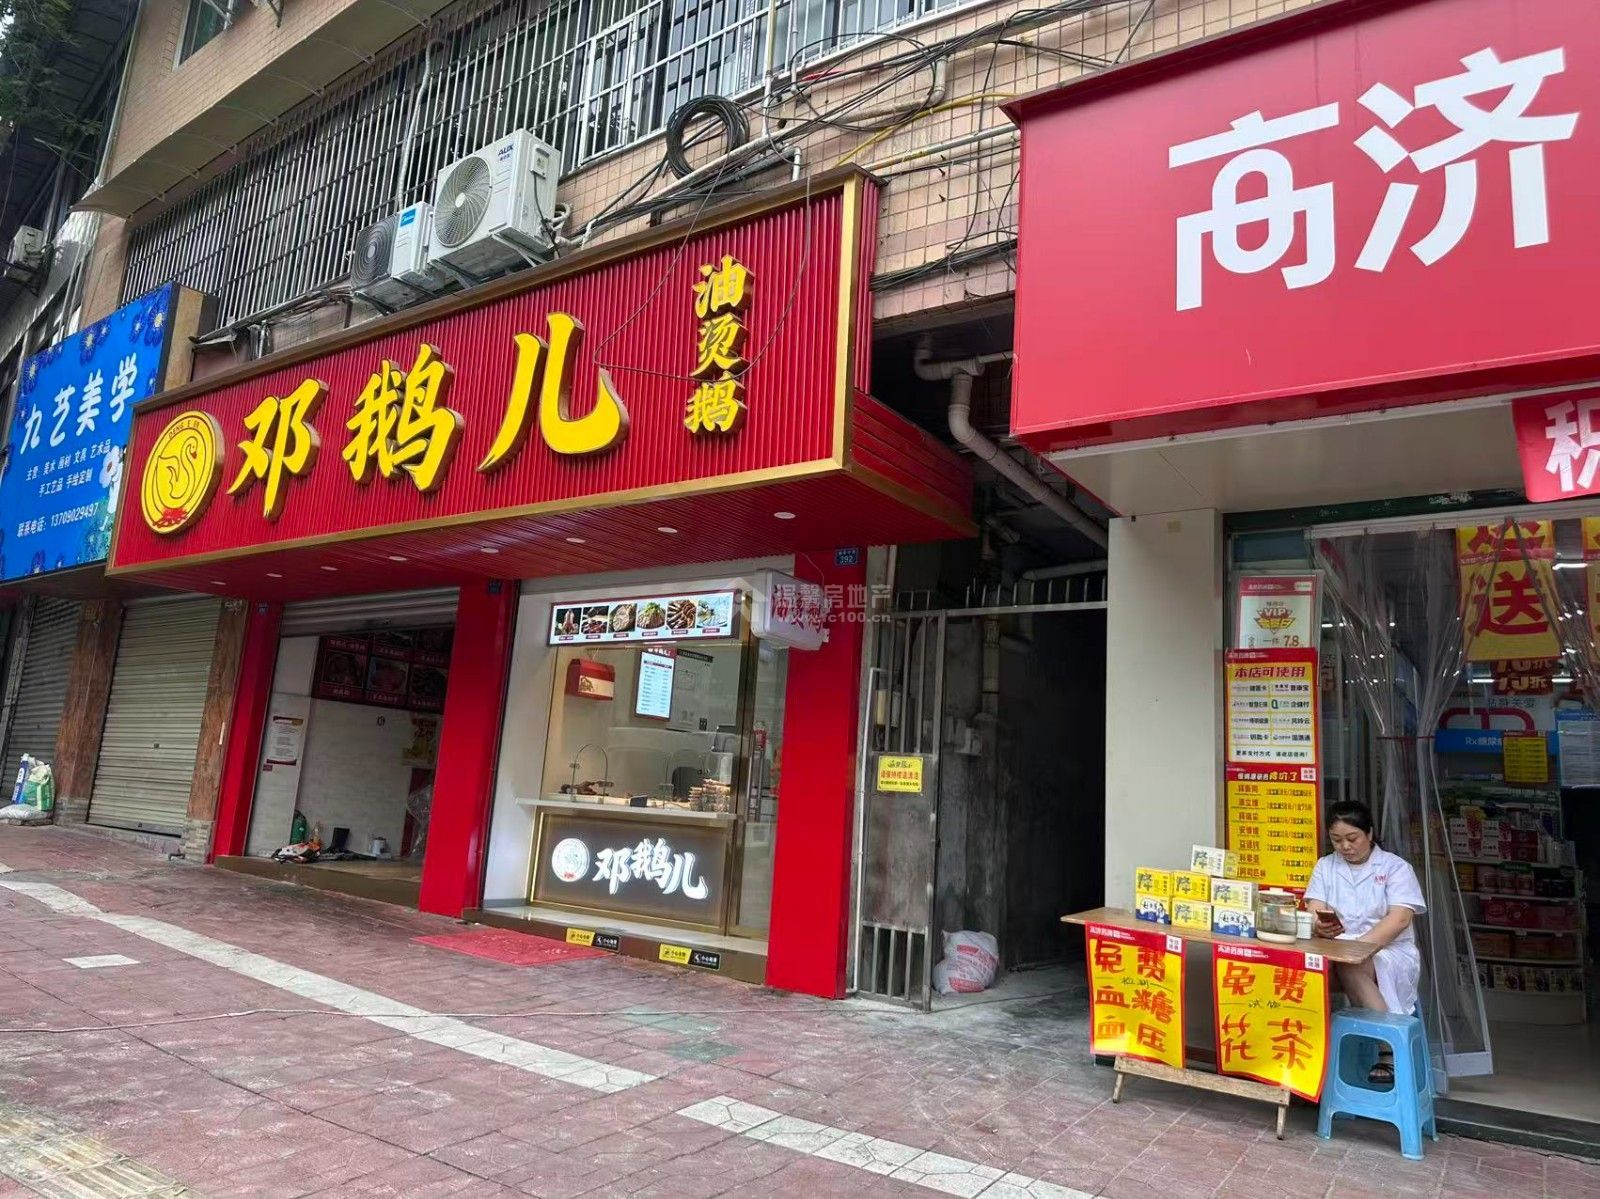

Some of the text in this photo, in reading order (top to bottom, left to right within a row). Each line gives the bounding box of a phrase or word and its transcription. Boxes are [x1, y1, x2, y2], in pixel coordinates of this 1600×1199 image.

[1168, 47, 1580, 312] 高济
[684, 255, 747, 435] 油烫鹅
[20, 352, 138, 455] 九艺美学
[226, 312, 628, 519] 邓鹅儿
[39, 477, 63, 497] 手工艺品
[1264, 607, 1287, 617] VIP
[1467, 571, 1549, 636] 送
[1234, 666, 1306, 678] 本店可使用
[1465, 735, 1503, 746] Rx糖尿
[592, 837, 709, 899] 邓鹅儿
[1094, 940, 1167, 983] 免费
[1221, 961, 1308, 1004] 免费
[1094, 985, 1176, 1026] 血糖
[1093, 1014, 1168, 1053] 血压
[1221, 1012, 1316, 1070] 花茶
